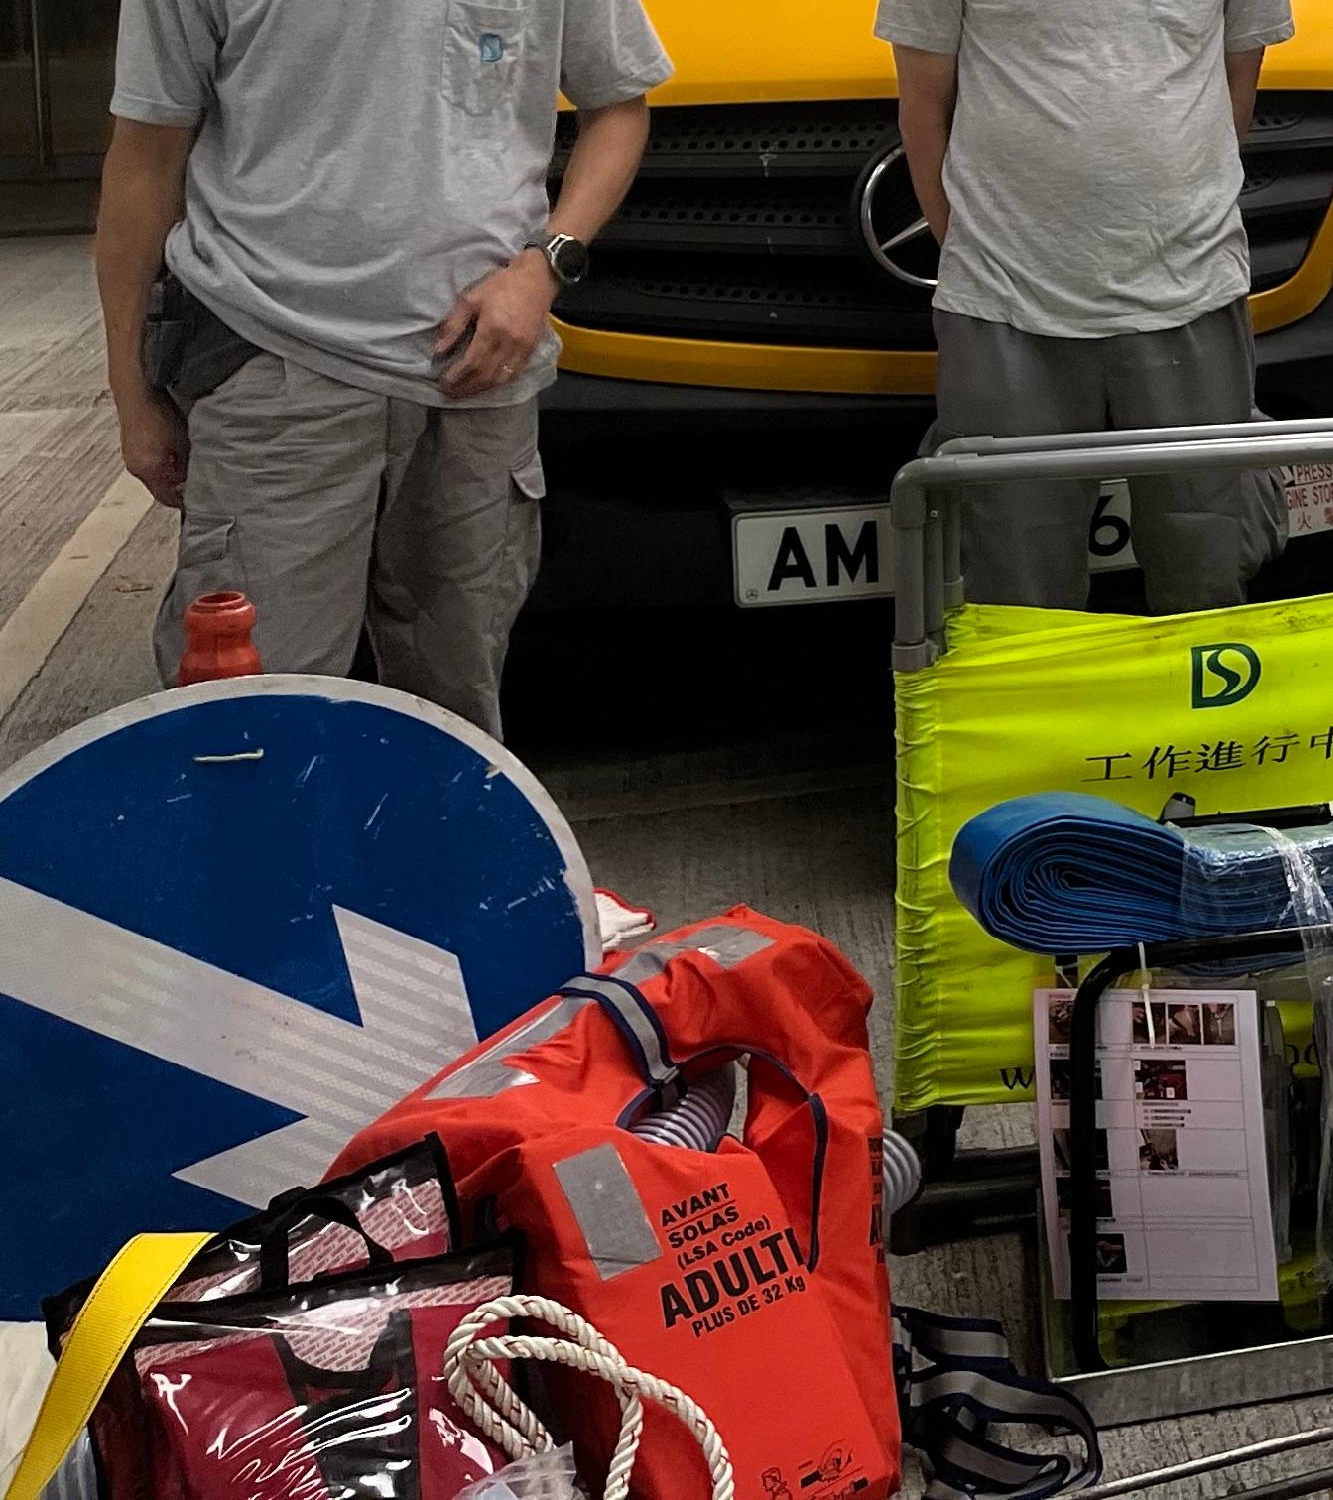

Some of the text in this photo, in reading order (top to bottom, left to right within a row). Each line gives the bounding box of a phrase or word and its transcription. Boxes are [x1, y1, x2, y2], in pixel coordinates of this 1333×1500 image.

[767, 520, 879, 592] AM
[661, 1183, 730, 1227] AVANT
[668, 1205, 740, 1249] SOLAS
[676, 1214, 771, 1270] (LSA Code)
[691, 1275, 806, 1338] PLUS DE 32 Kg
